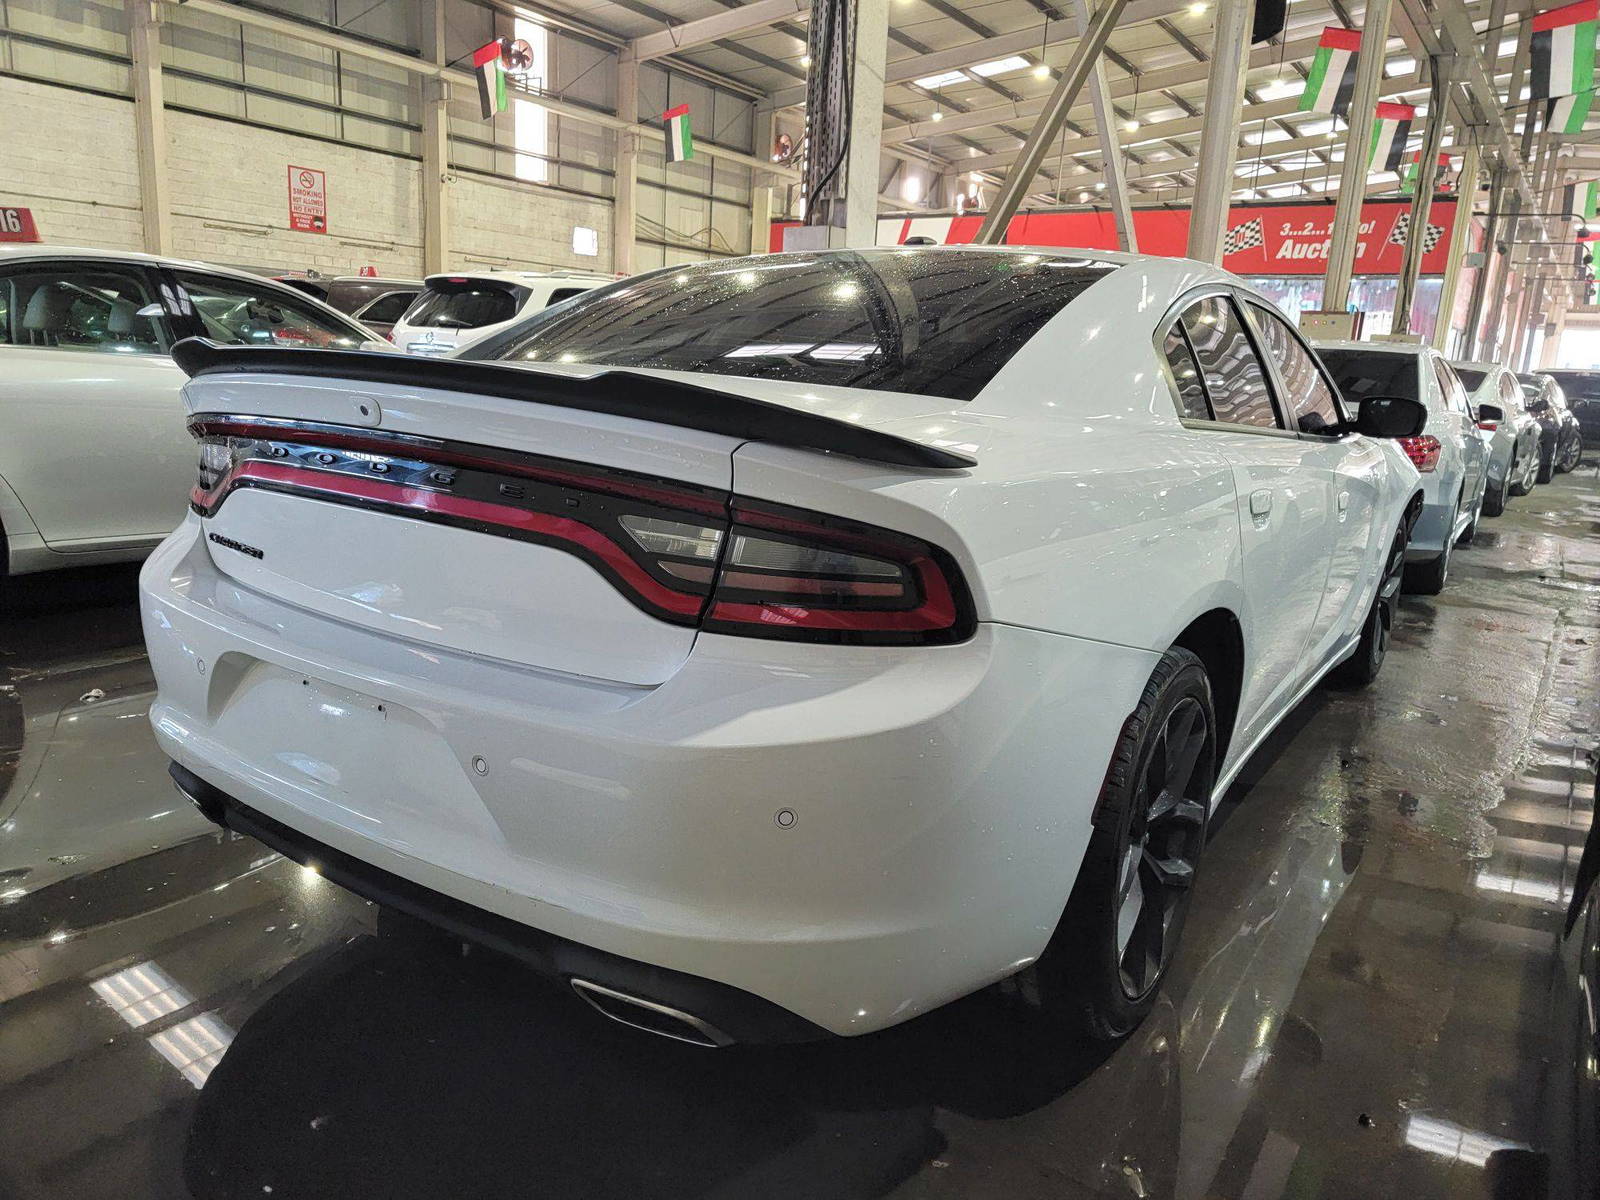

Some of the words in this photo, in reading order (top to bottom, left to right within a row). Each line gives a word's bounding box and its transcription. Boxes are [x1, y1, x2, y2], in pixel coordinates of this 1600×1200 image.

[293, 188, 322, 199] SMOKING
[303, 198, 323, 207] ALLOWED
[304, 207, 323, 215] ENTRY
[1276, 239, 1367, 259] Auctn
[269, 445, 525, 499] DODGE
